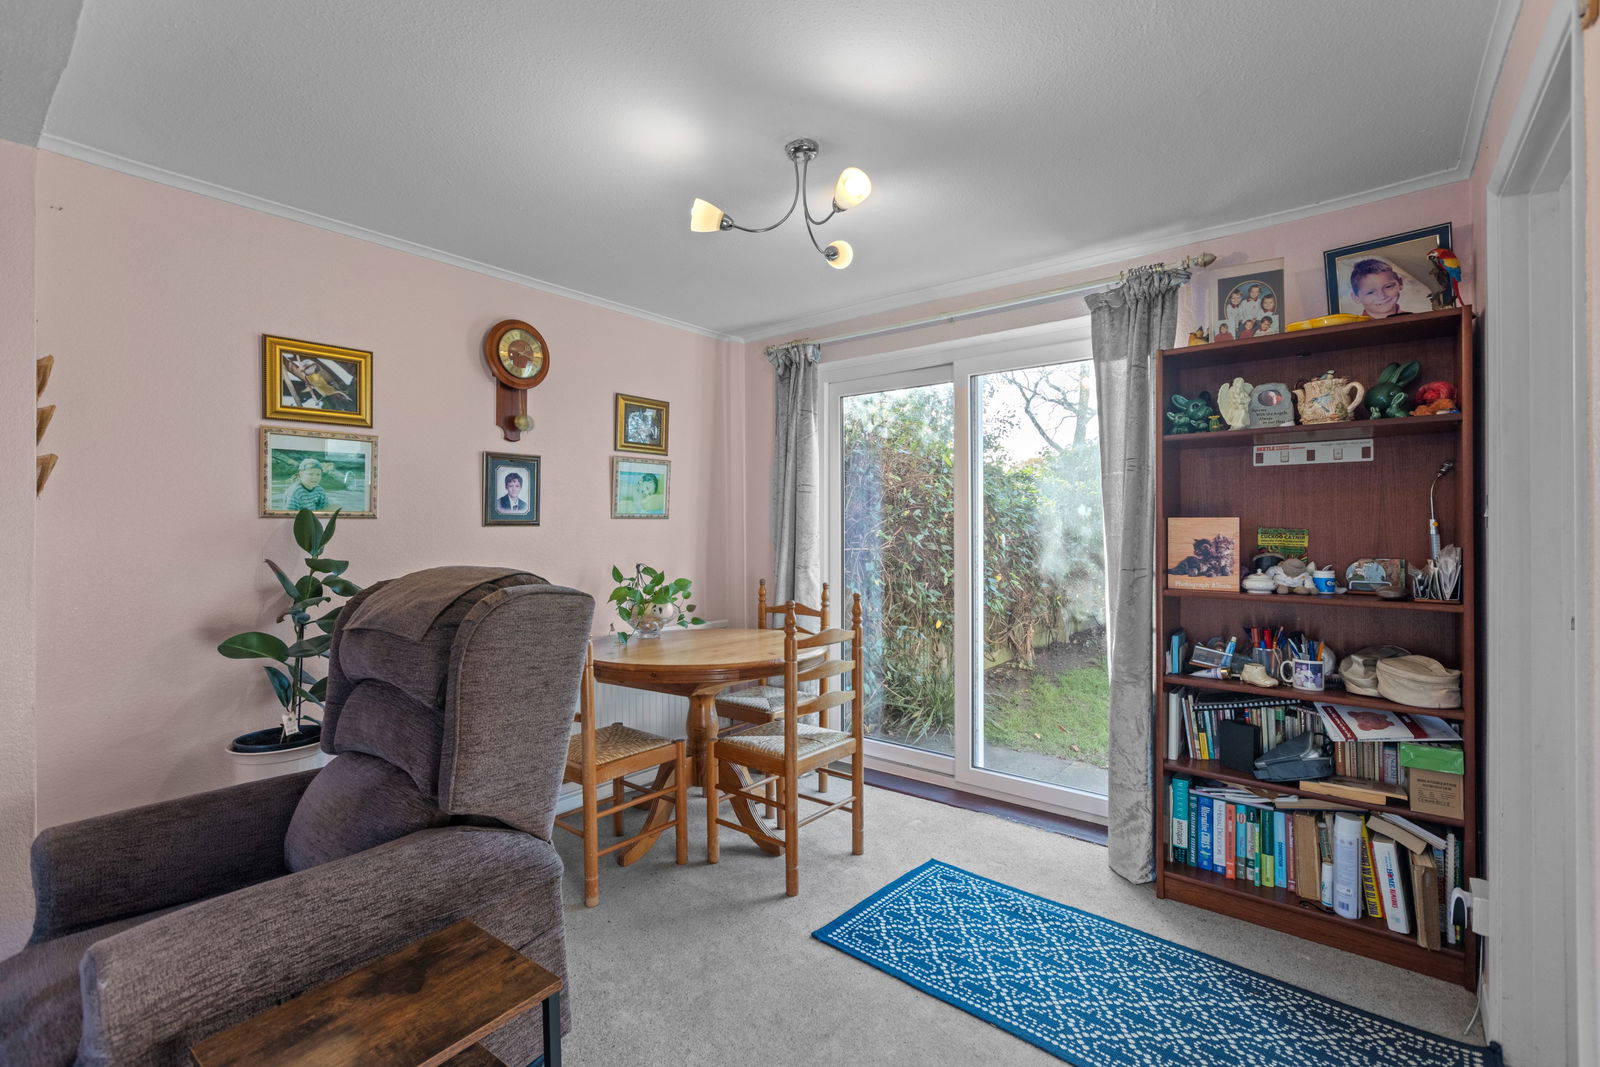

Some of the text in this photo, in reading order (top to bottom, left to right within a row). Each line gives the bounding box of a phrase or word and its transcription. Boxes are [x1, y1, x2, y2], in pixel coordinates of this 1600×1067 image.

[1175, 820, 1183, 846] antiques
[1362, 867, 1372, 876] AN
[1365, 884, 1375, 892] DO
[1367, 900, 1379, 916] WHAT
